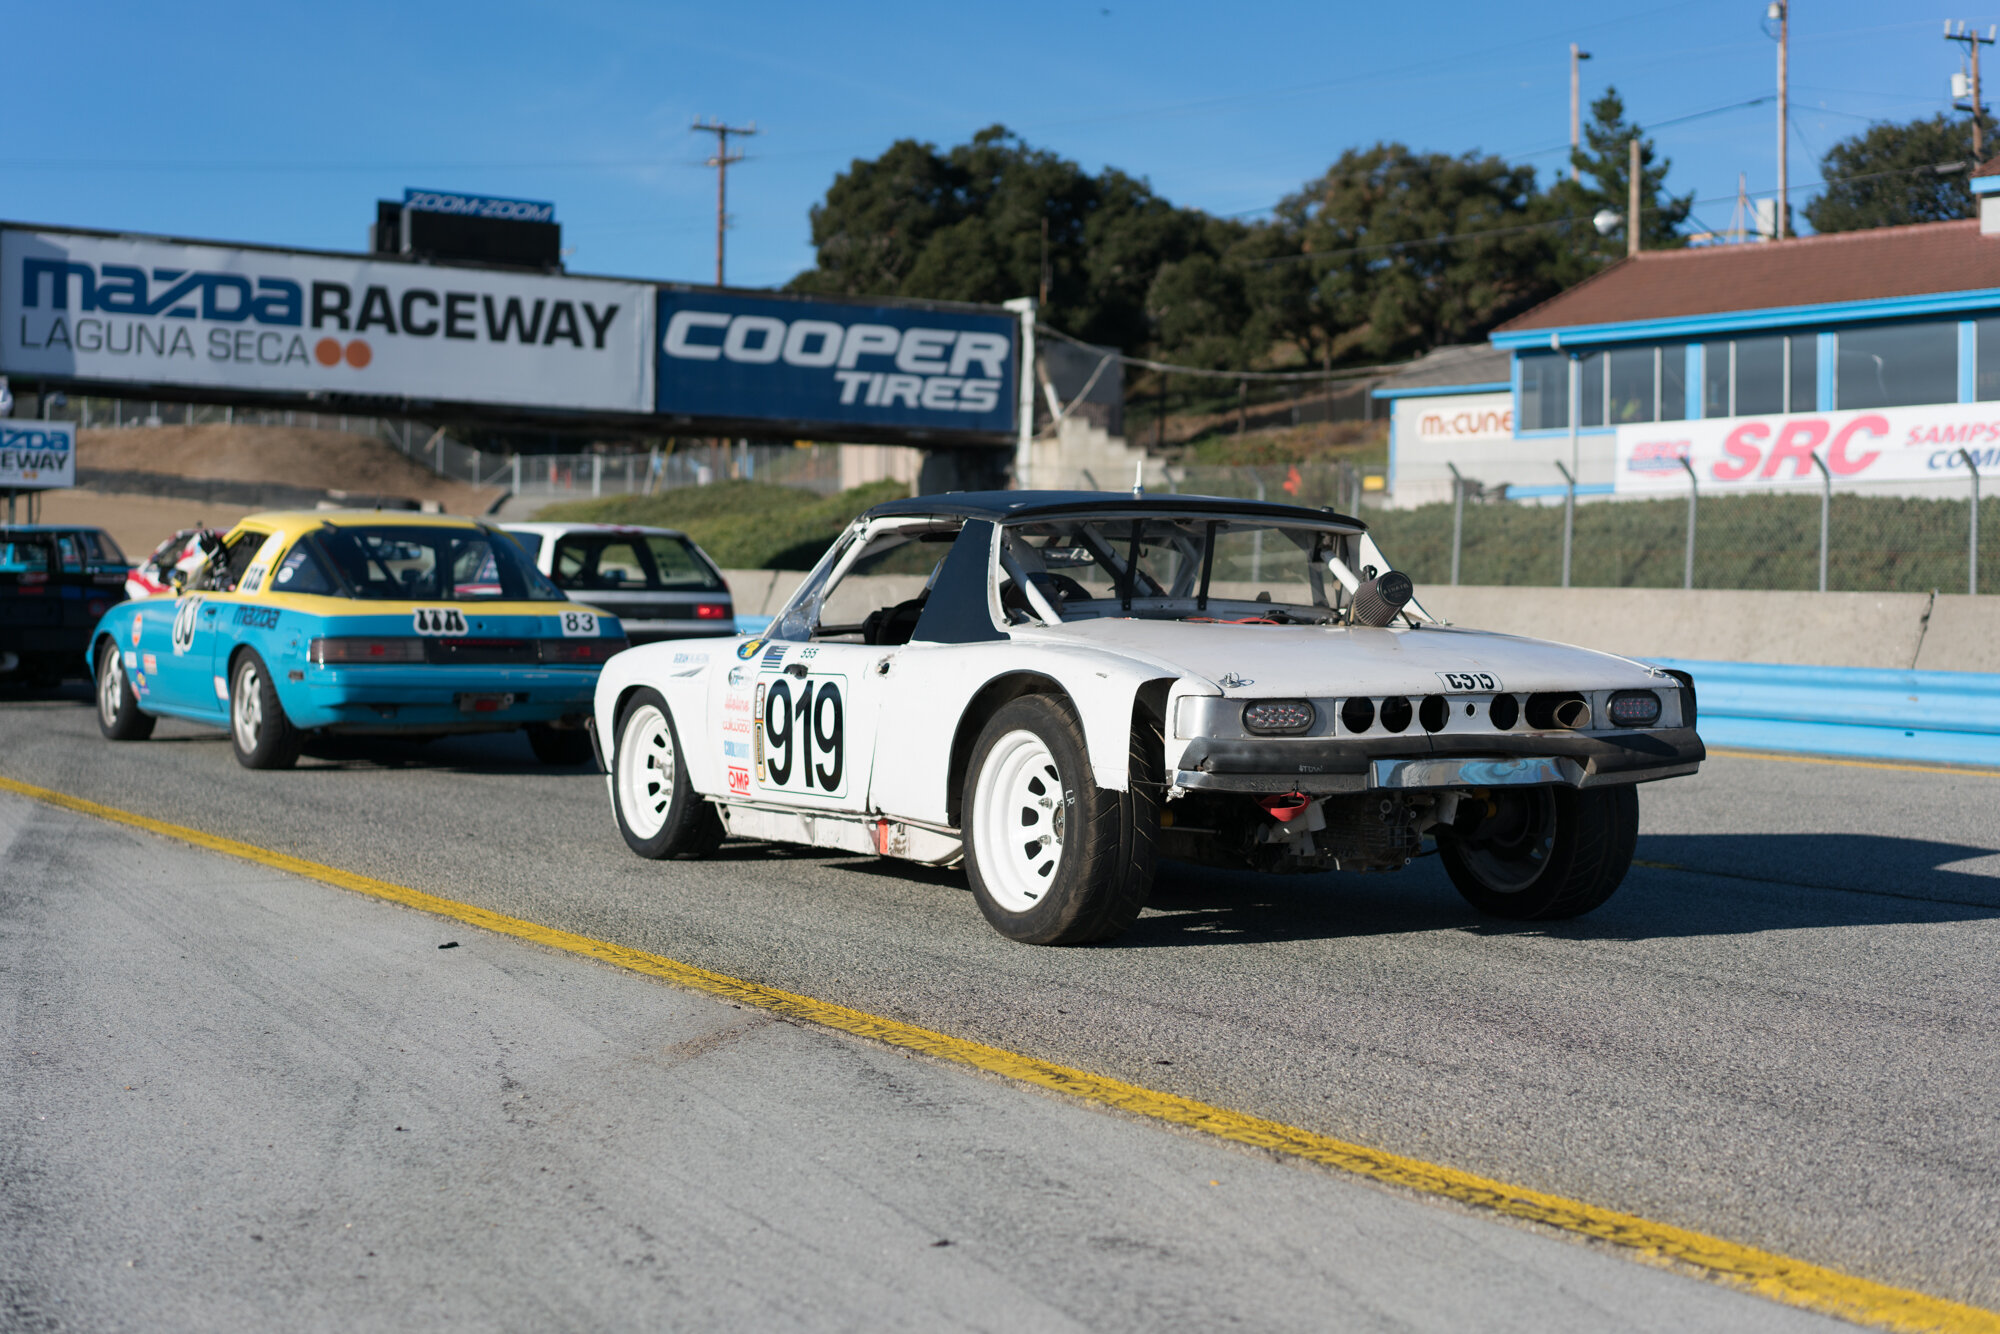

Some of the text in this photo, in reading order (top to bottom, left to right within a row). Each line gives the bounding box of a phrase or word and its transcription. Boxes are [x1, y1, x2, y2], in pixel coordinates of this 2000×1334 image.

[405, 192, 552, 221] ZOOM-ZOOM
[20, 314, 310, 366] LAGUNA SECA
[311, 280, 619, 349] RACEWAY
[663, 310, 1010, 378] COOPER
[835, 371, 1001, 413] TIRES
[1713, 414, 1889, 481] SRC
[566, 613, 595, 632] 83
[765, 679, 844, 792] 919
[728, 770, 750, 791] OMP
